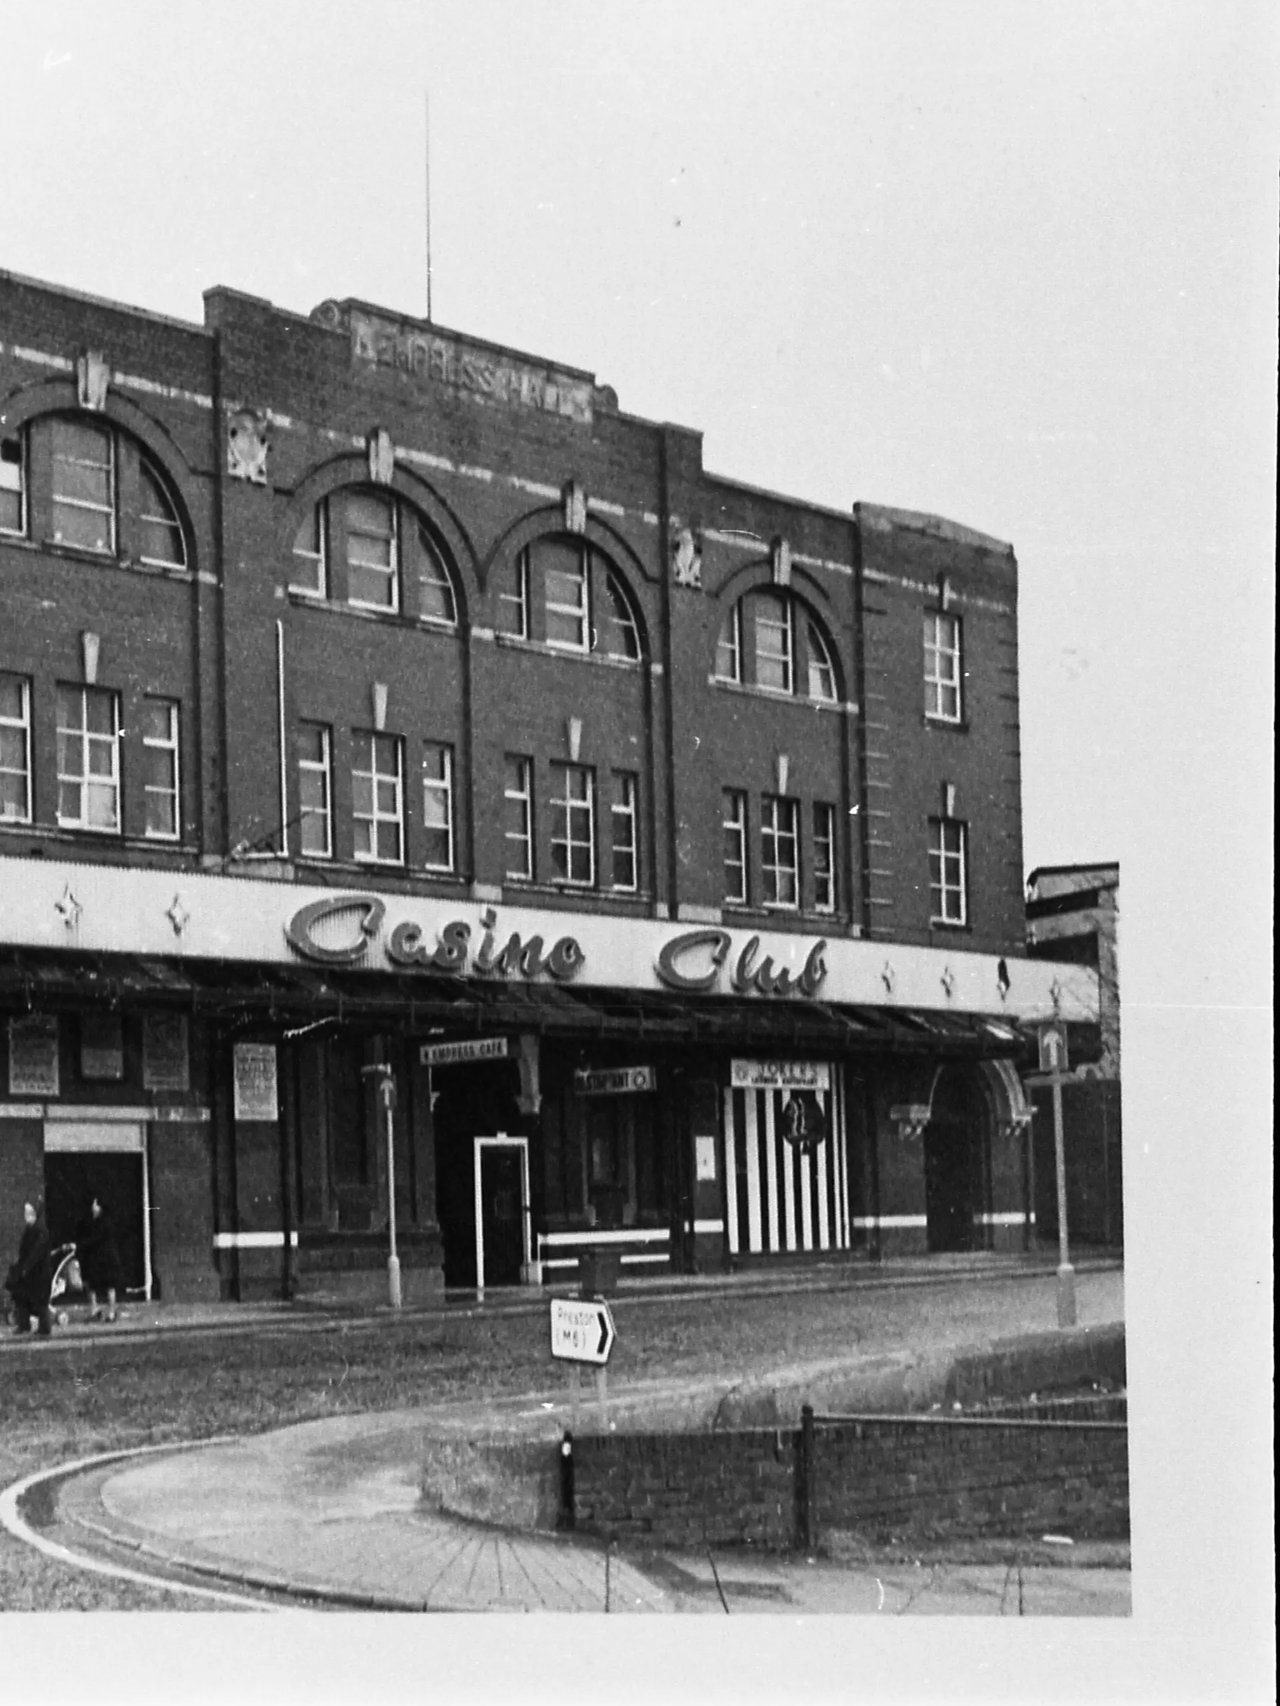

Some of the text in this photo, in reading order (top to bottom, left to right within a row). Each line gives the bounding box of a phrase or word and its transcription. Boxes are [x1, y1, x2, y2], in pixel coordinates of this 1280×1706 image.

[285, 894, 827, 997] Casino Club
[557, 1306, 595, 1326] Preston
